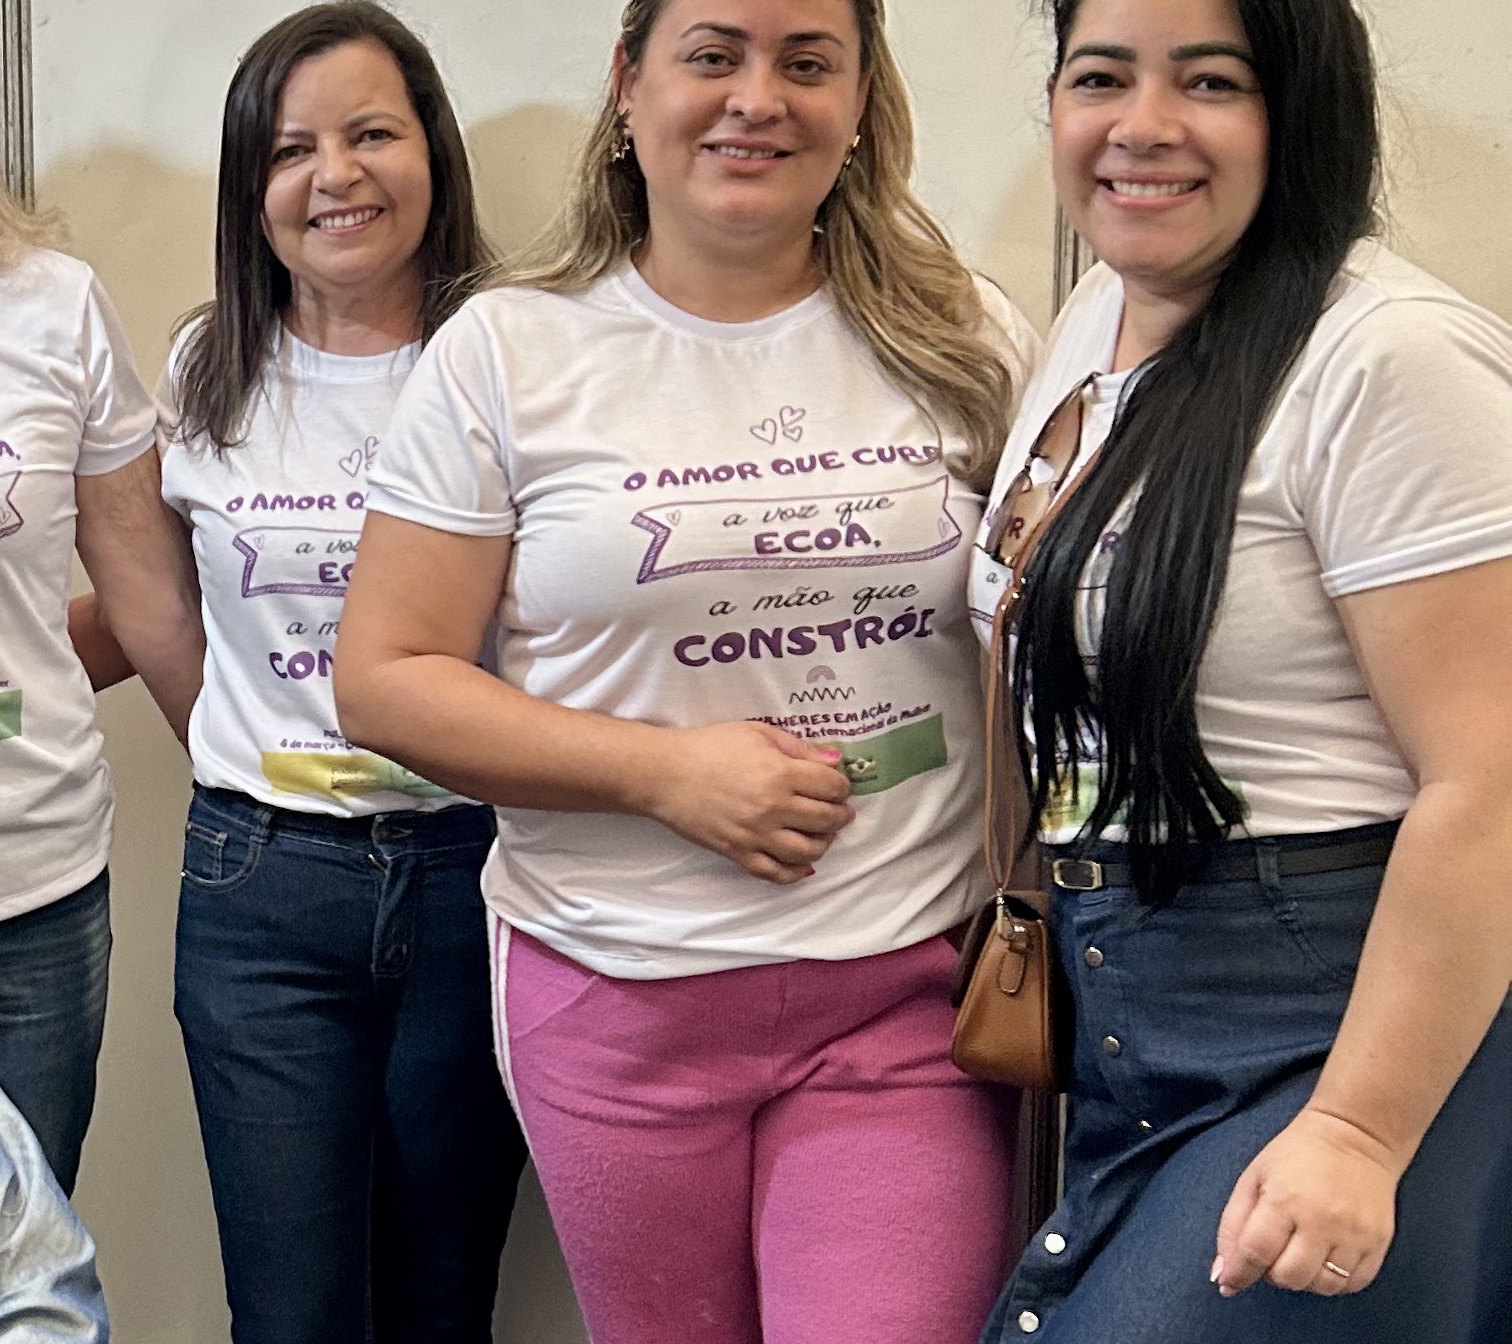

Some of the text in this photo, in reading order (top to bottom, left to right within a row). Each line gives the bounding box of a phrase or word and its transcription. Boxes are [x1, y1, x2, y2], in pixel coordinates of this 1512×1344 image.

[657, 462, 763, 488] AMOR
[771, 451, 844, 476] QUE
[250, 493, 336, 510] AMOR
[722, 496, 895, 527] a voz que
[295, 542, 315, 555] a
[754, 523, 881, 554] ECOA.
[709, 583, 920, 616] a mão que
[286, 621, 308, 635] a
[834, 712, 858, 723] EM
